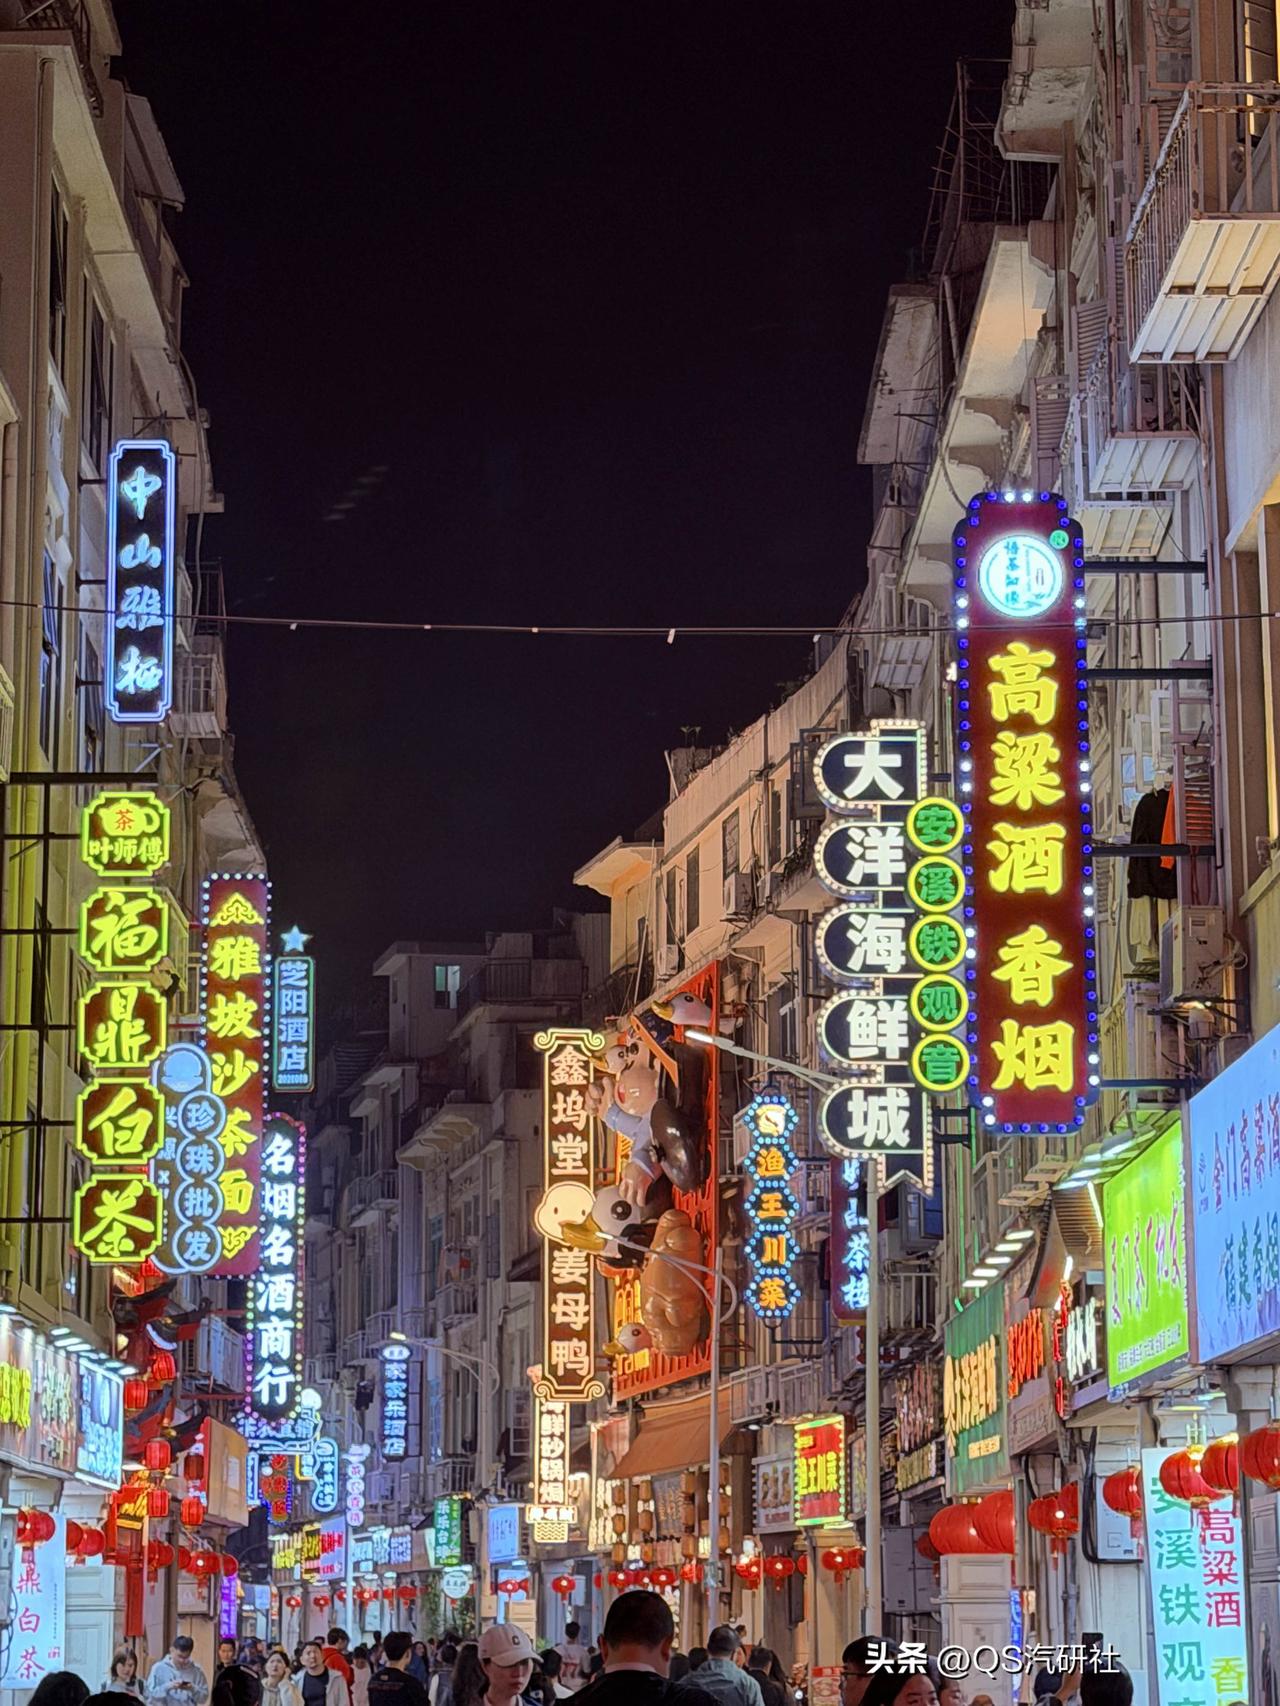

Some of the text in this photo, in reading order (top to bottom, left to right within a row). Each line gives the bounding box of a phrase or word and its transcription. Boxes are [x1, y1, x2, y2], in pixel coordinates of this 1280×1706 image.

[88, 836, 163, 865] 叶师傅
[114, 809, 135, 830] 茶
[843, 741, 911, 1149] 大洋海鲜城
[915, 806, 961, 1083] 安溪铁观音
[83, 891, 159, 1257] 福鼎白茶
[207, 935, 262, 1215] 雅坡沙茶面
[183, 1101, 217, 1262] 珍珠批发
[756, 1147, 788, 1309] 渔王川菜
[254, 1132, 297, 1405] 名烟名酒商行
[550, 1246, 590, 1377] 姜母鸭
[1150, 1476, 1205, 1706] 安溪铁观
[1198, 1508, 1241, 1628] 高粱酒
[1210, 1655, 1246, 1706] 香
